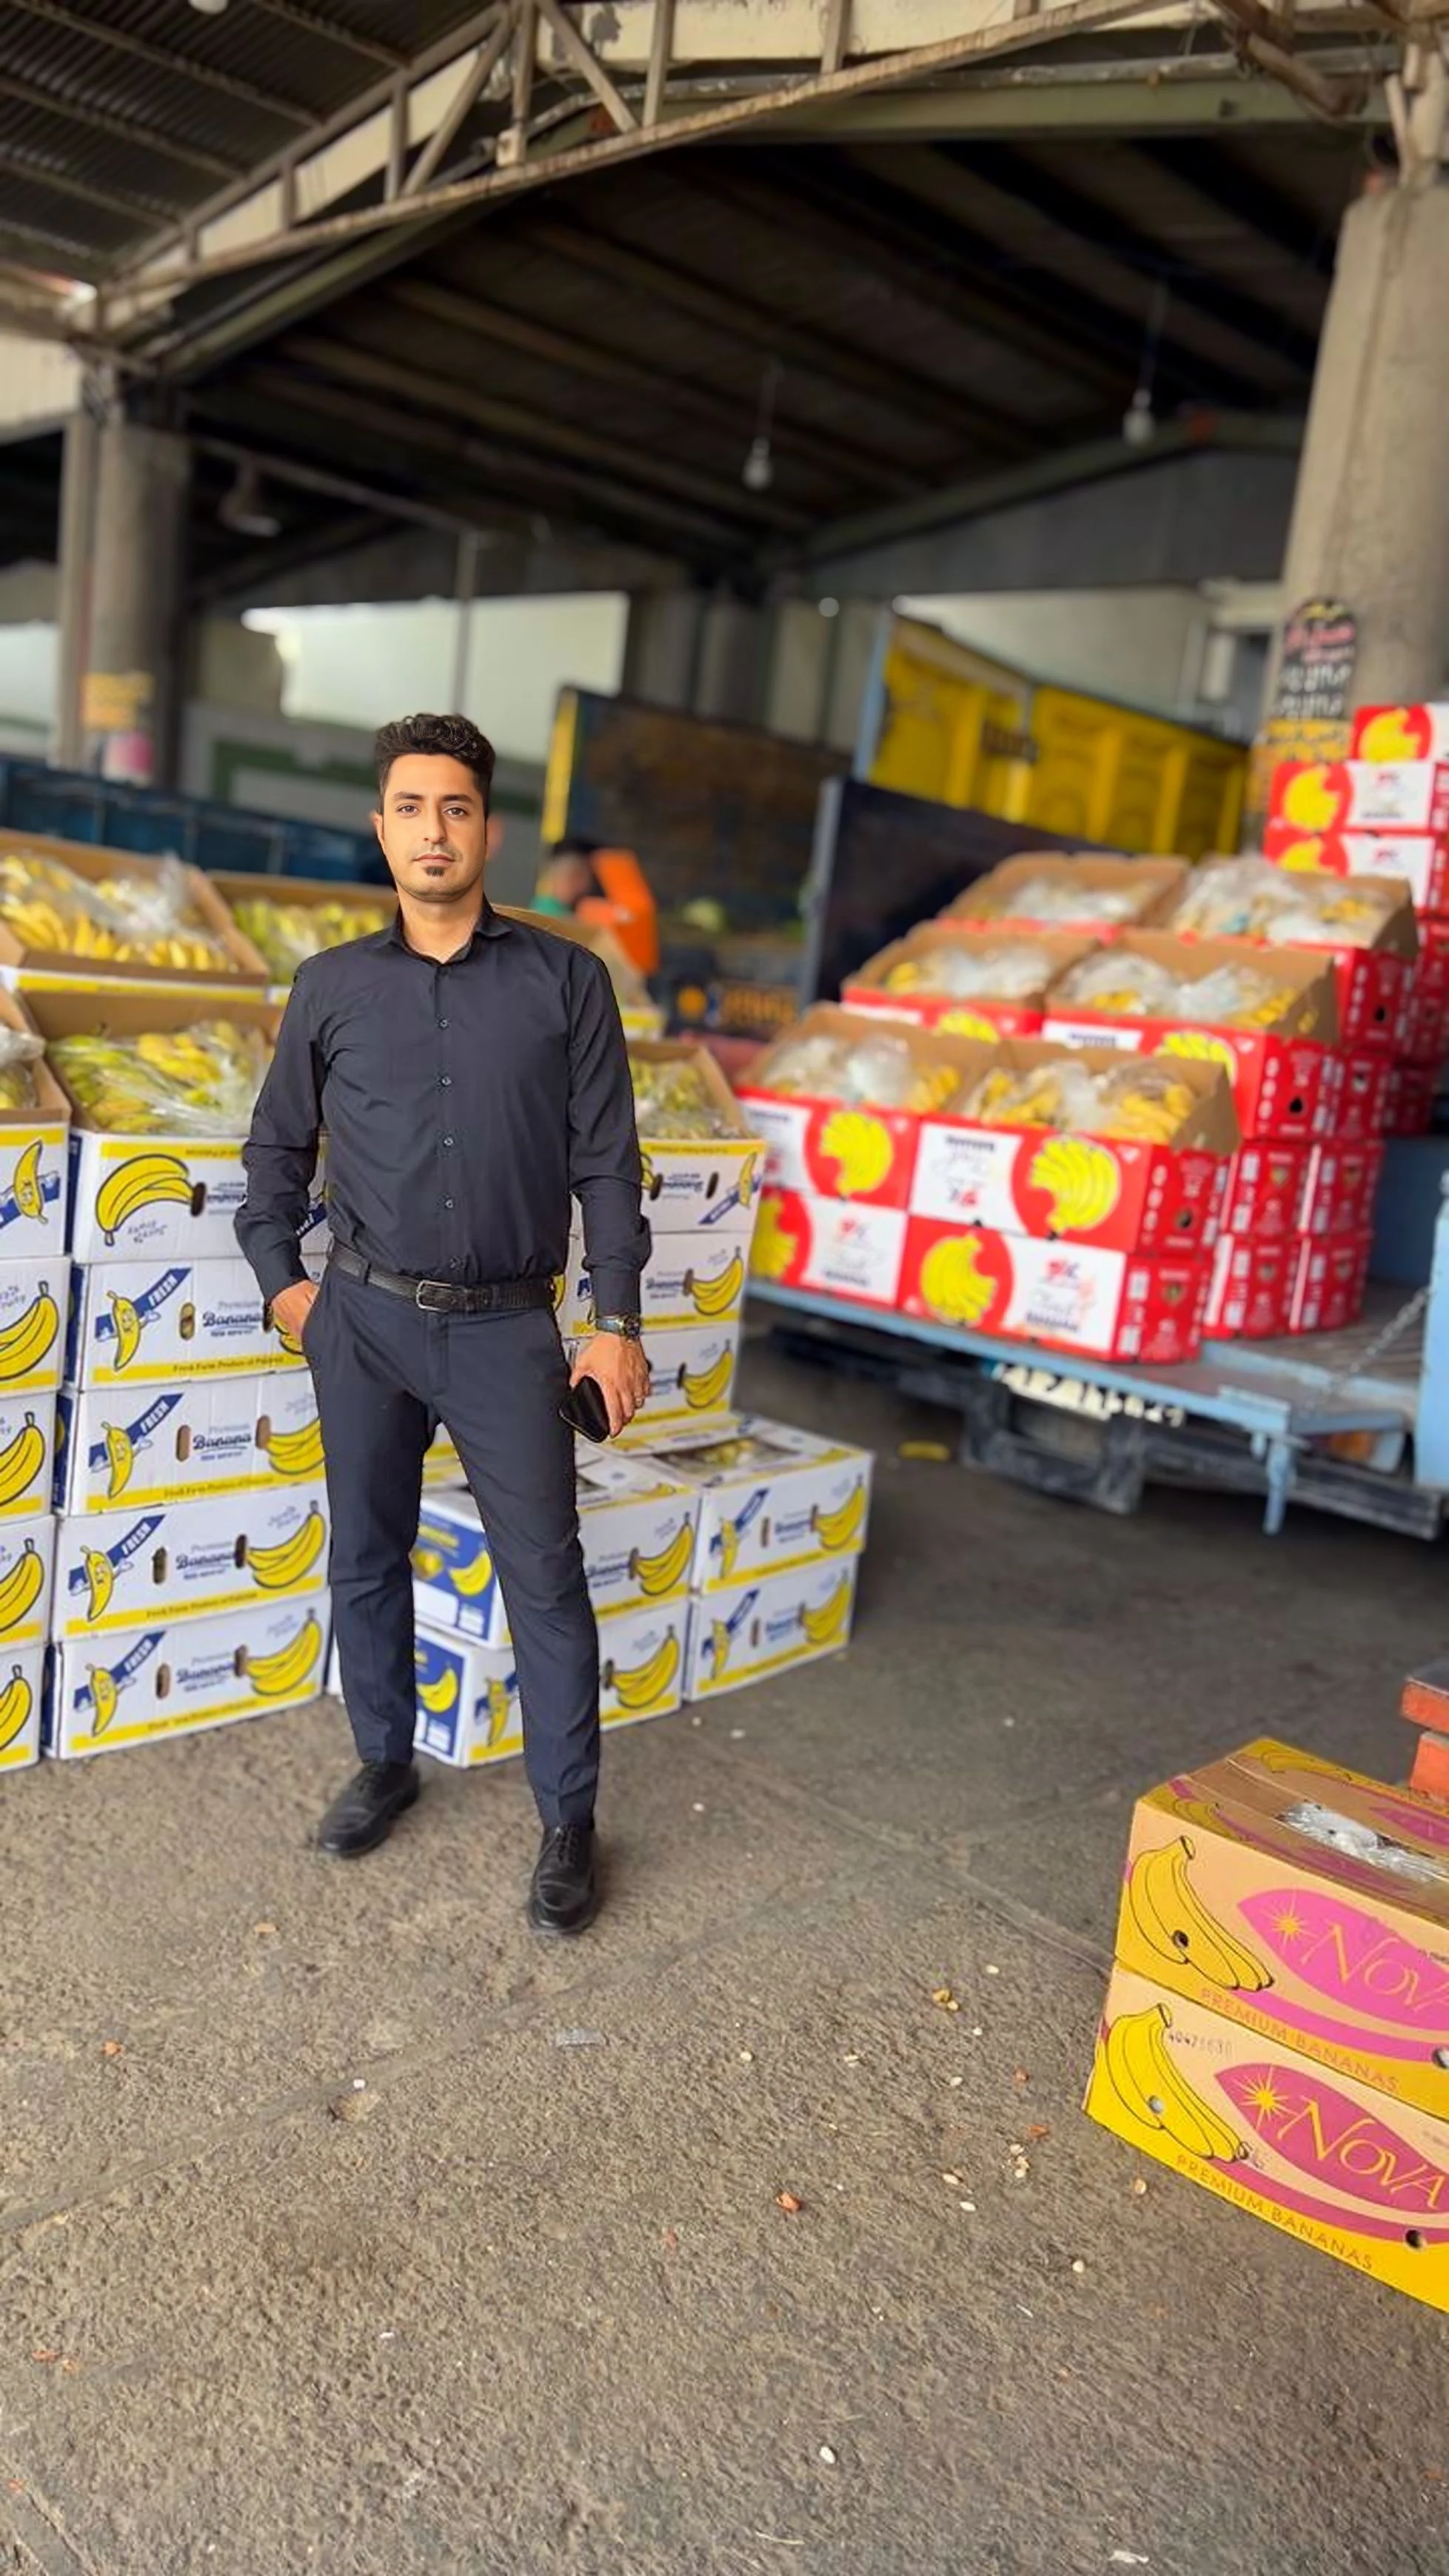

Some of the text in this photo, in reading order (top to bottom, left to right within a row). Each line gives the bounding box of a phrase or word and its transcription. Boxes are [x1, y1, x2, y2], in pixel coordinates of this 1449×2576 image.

[149, 1275, 178, 1306] FRESH
[202, 1311, 262, 1327] Banana
[140, 1401, 169, 1432] FRESH
[193, 1434, 252, 1450] Banana
[1201, 1988, 1399, 2092] PREMIUM BANANAS
[1277, 2095, 1445, 2209] NOVA
[1176, 2154, 1263, 2212] PREMIUM
[1271, 2206, 1373, 2270] BANANAS
